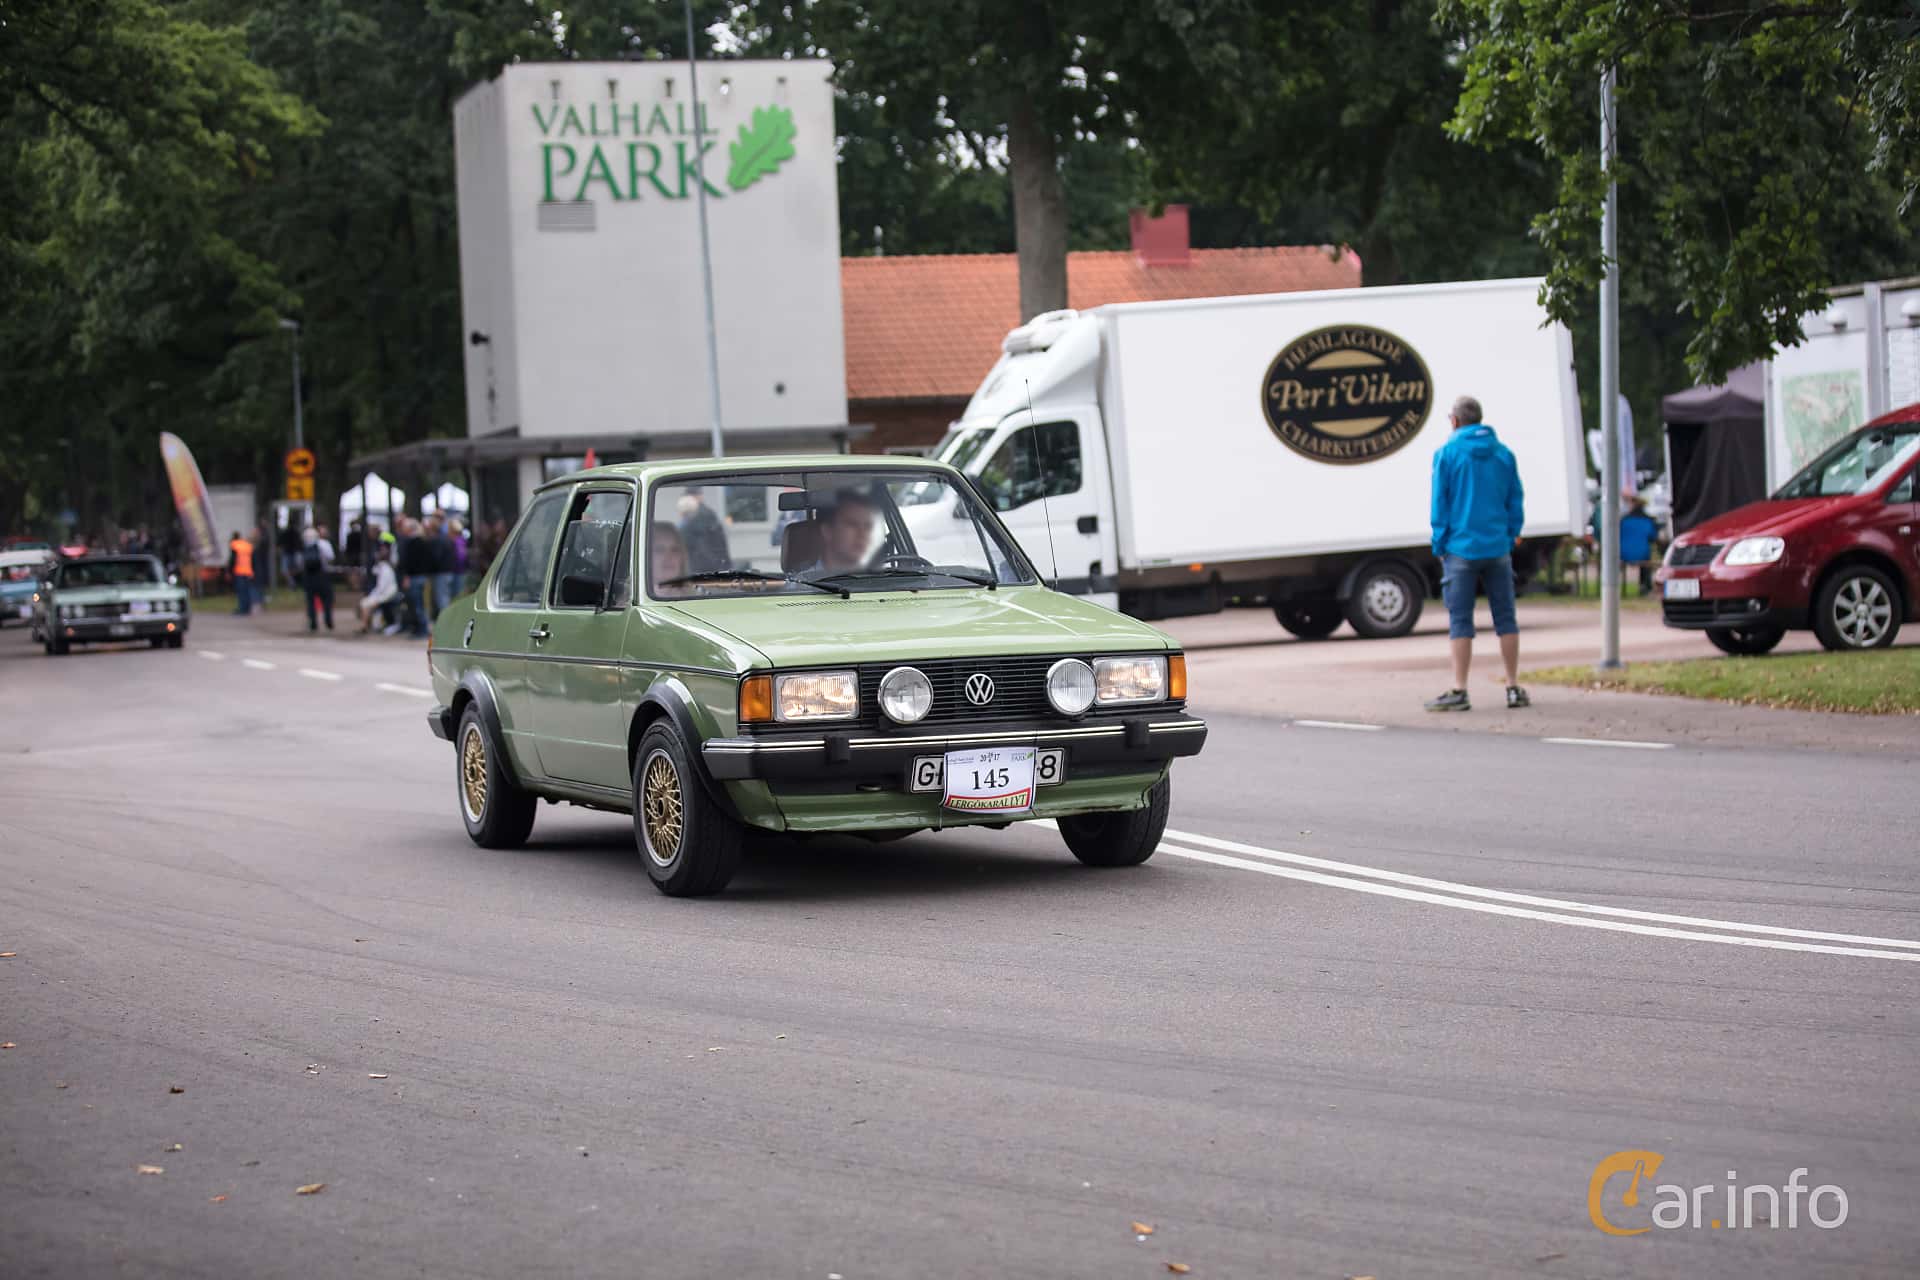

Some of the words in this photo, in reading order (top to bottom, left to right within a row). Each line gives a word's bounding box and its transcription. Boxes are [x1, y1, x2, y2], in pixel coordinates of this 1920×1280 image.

[531, 103, 719, 136] VALHALL
[541, 141, 726, 201] PARK
[1284, 330, 1403, 370] HEMLAGADE
[1270, 379, 1325, 411] Per
[1340, 372, 1425, 405] Viken
[1281, 409, 1421, 455] CHARKUTERIER
[972, 768, 1010, 790] 145
